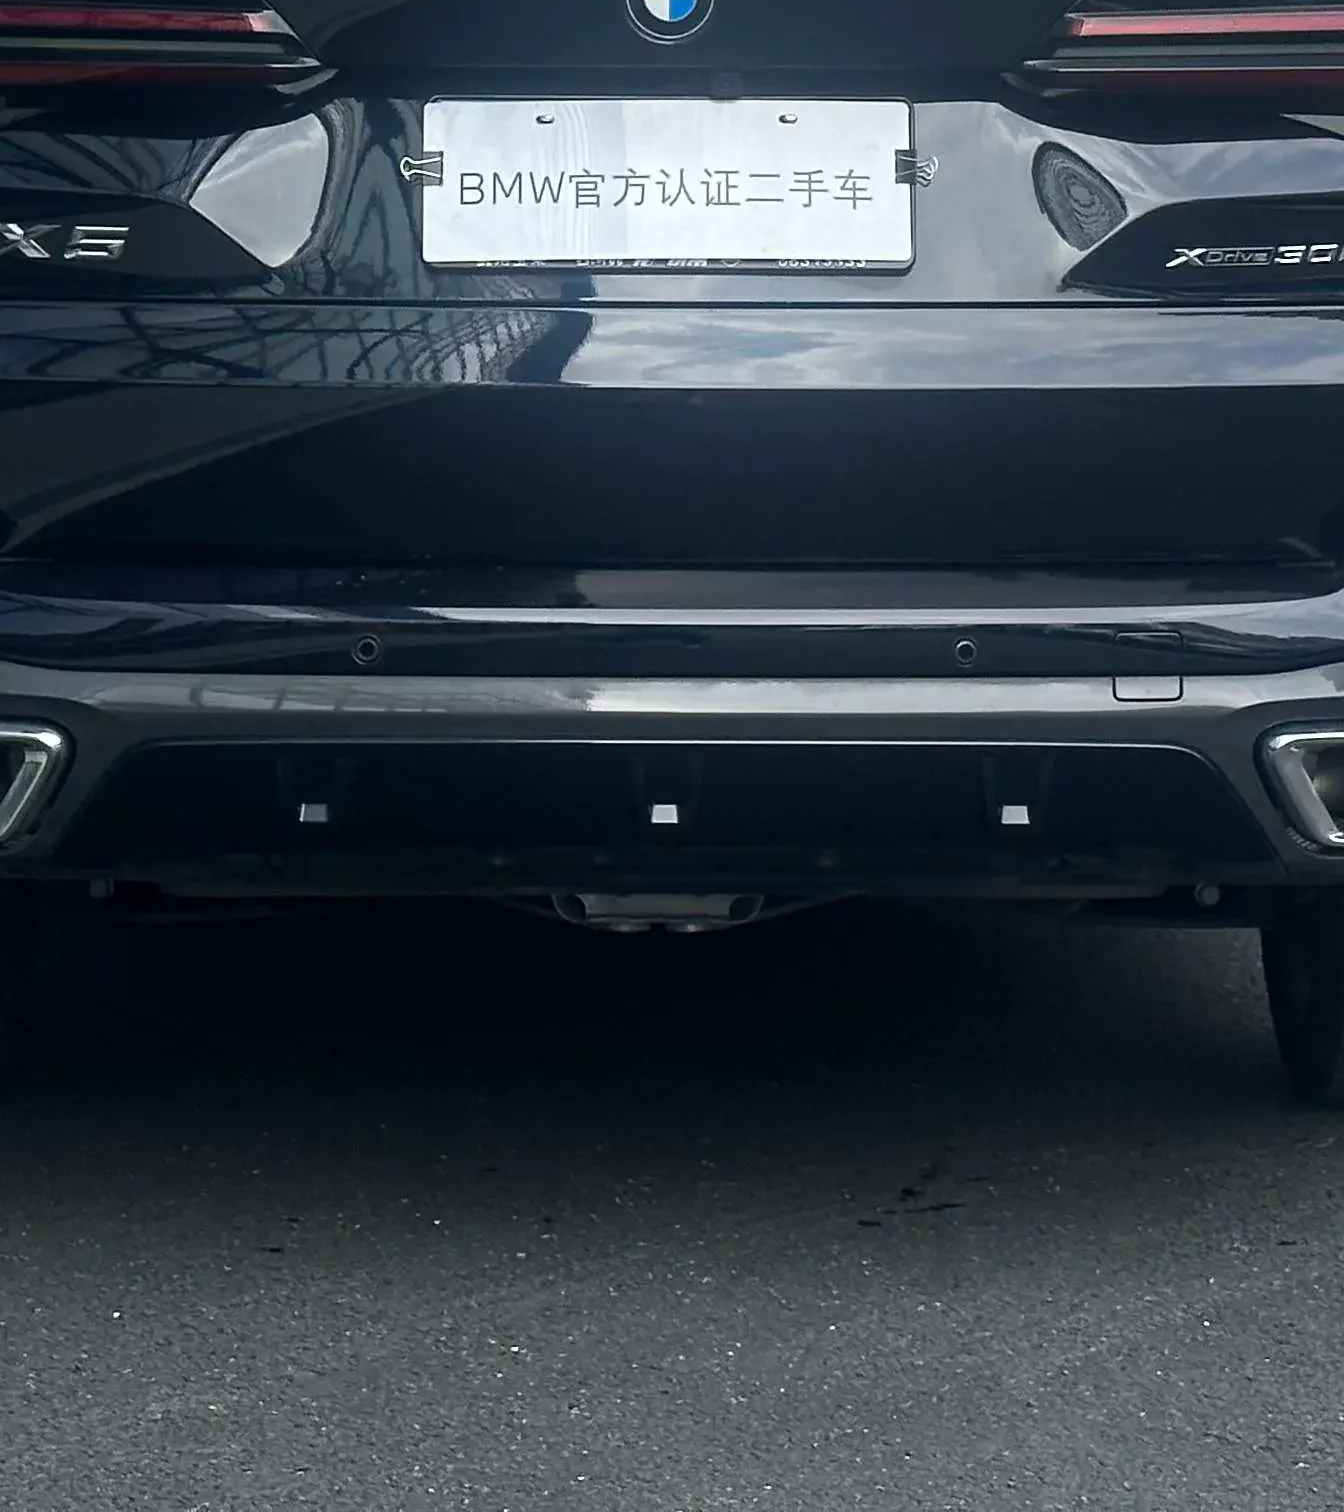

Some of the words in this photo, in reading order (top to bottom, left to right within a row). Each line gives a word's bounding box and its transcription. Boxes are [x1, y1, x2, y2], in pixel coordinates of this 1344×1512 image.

[458, 168, 874, 210] BMW官方认证二手车
